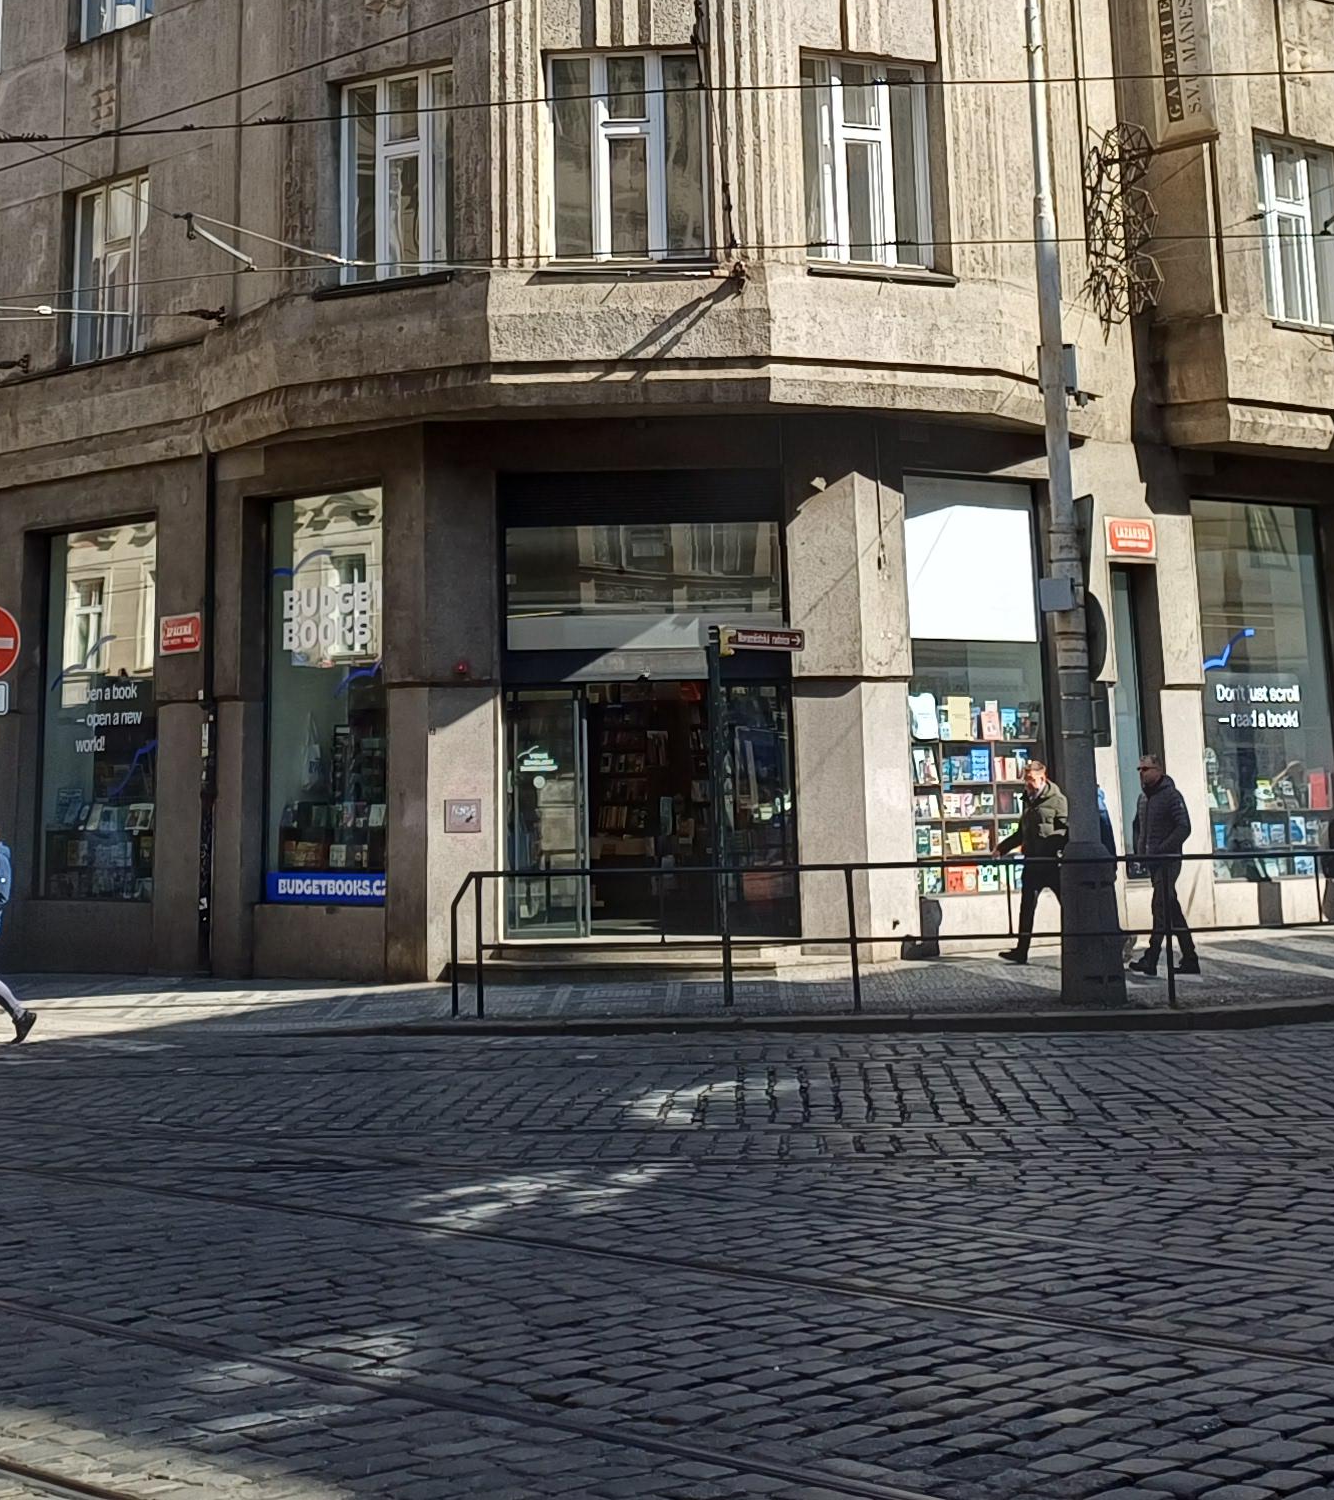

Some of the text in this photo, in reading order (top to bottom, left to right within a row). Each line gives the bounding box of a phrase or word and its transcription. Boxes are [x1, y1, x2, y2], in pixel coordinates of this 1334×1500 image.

[112, 684, 138, 700] book
[1269, 684, 1300, 702] scroll
[87, 713, 112, 730] open
[121, 711, 143, 725] new
[1230, 709, 1257, 728] read
[75, 735, 106, 753] world!
